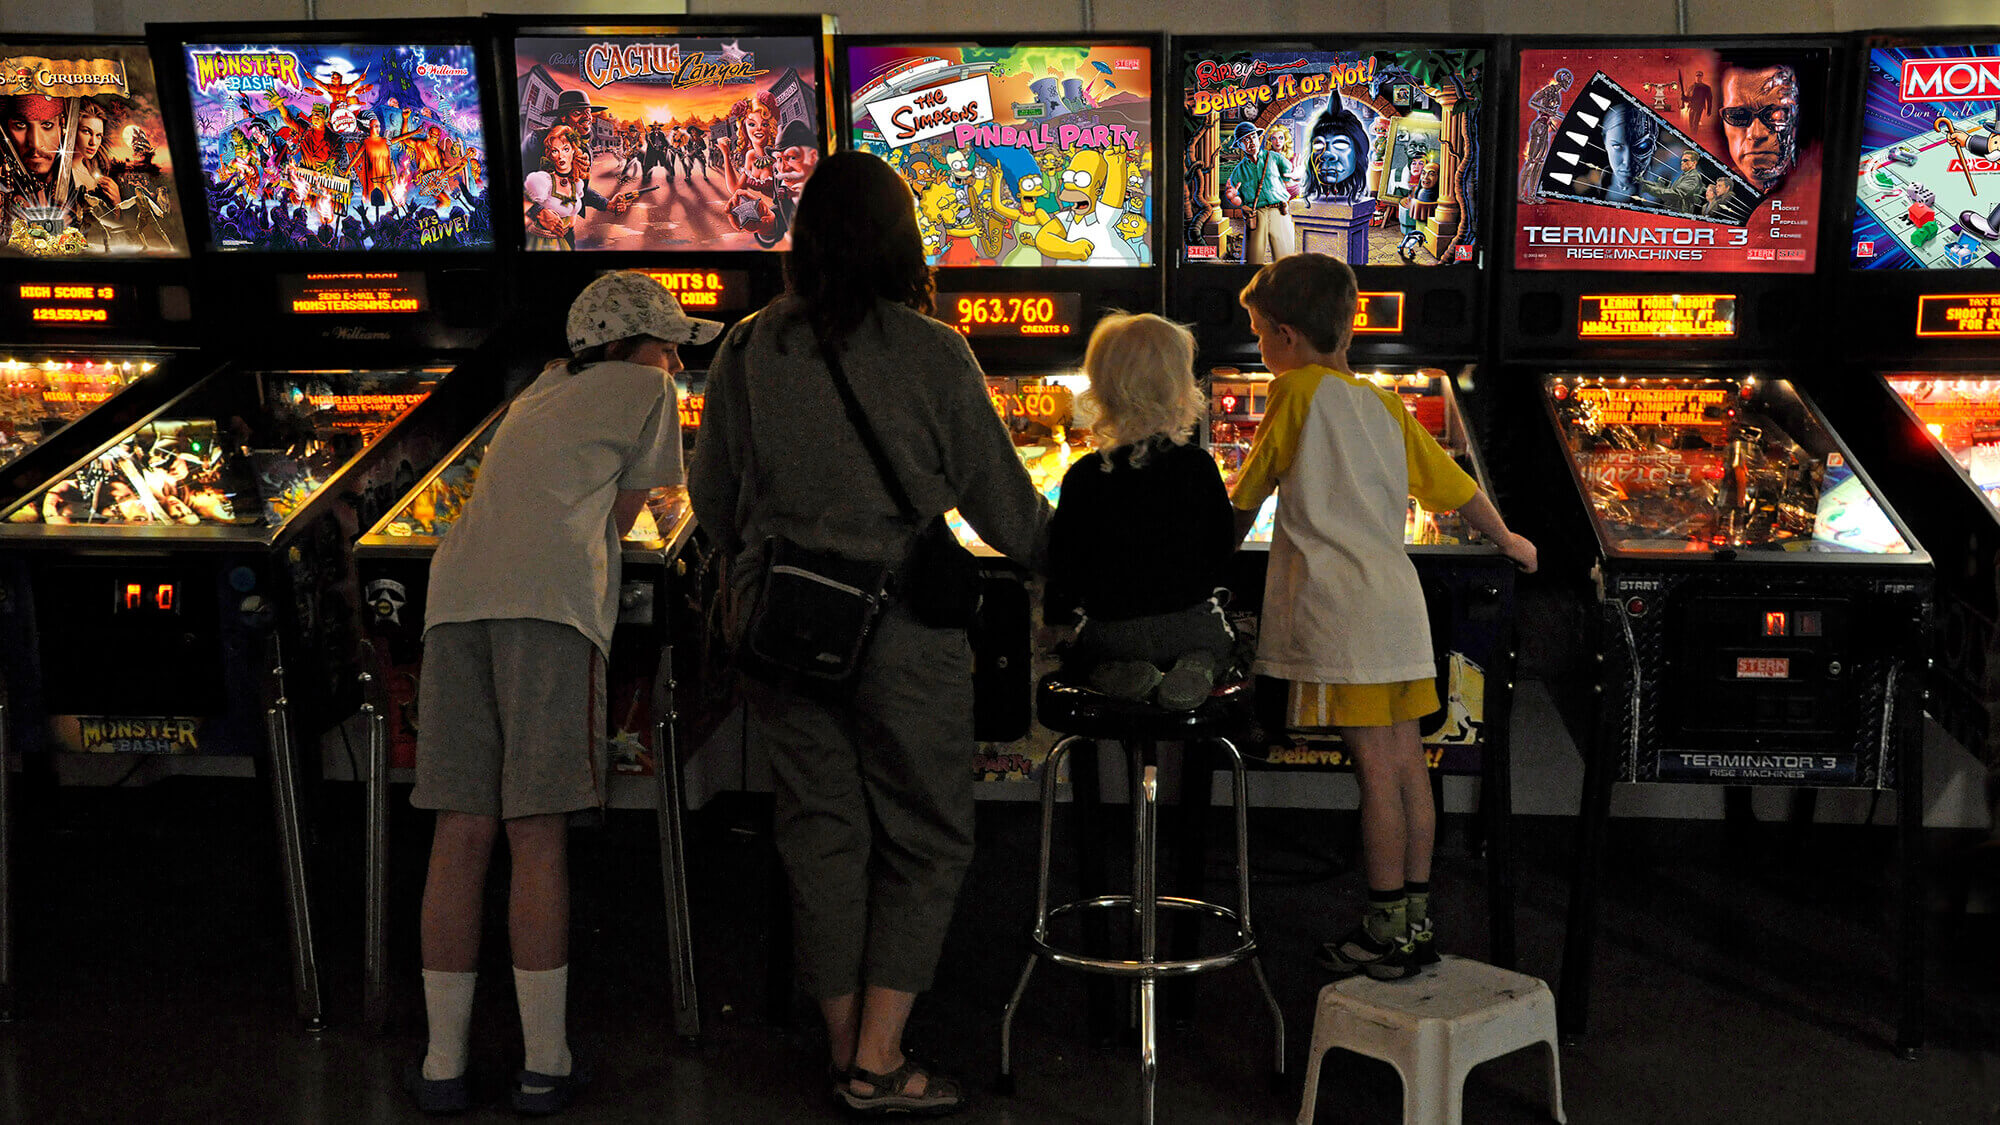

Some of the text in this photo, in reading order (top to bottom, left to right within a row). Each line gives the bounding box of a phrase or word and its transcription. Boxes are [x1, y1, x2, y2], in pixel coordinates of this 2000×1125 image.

[549, 52, 578, 67] Bally
[584, 42, 680, 89] CACTUS
[196, 54, 300, 92] MONSTER
[427, 65, 468, 75] Williams
[671, 52, 769, 90] Canyon
[38, 69, 124, 86] CARIBBEAN
[227, 76, 275, 91] BASH
[1193, 56, 1378, 116] Believe It or Not!
[1901, 102, 1974, 118] Own it all
[891, 101, 978, 139] SIMPSONS
[954, 124, 1139, 152] PINBALL PARTY
[419, 215, 438, 230] IT'S
[421, 214, 469, 246] ALIVE!
[1523, 226, 1748, 245] TERMINATOR 3
[1188, 246, 1217, 255] STERN
[1566, 248, 1604, 259] RISE
[1613, 249, 1703, 261] MACHINES
[1747, 249, 1774, 257] STERN
[20, 286, 51, 299] HIGH
[54, 286, 94, 299] SCORE
[318, 292, 342, 300] SEND
[343, 292, 376, 300] E-MAIL
[681, 292, 718, 305] COINS
[1600, 298, 1715, 309] LEARN MORE ABOUT
[1968, 298, 1988, 306] TAX
[1600, 309, 1715, 321] STERN PINBALL AT
[1946, 307, 1987, 320] SHOOT
[1020, 325, 1060, 334] CREDITS
[1959, 319, 1983, 330] FOR
[1619, 580, 1660, 590] START
[1738, 659, 1788, 672] STERN
[82, 719, 198, 749] MONSTER
[119, 740, 170, 753] BASH
[1266, 745, 1343, 766] Believe
[1680, 754, 1837, 769] TERMINATOR 3
[1743, 769, 1805, 779] MACHINES
